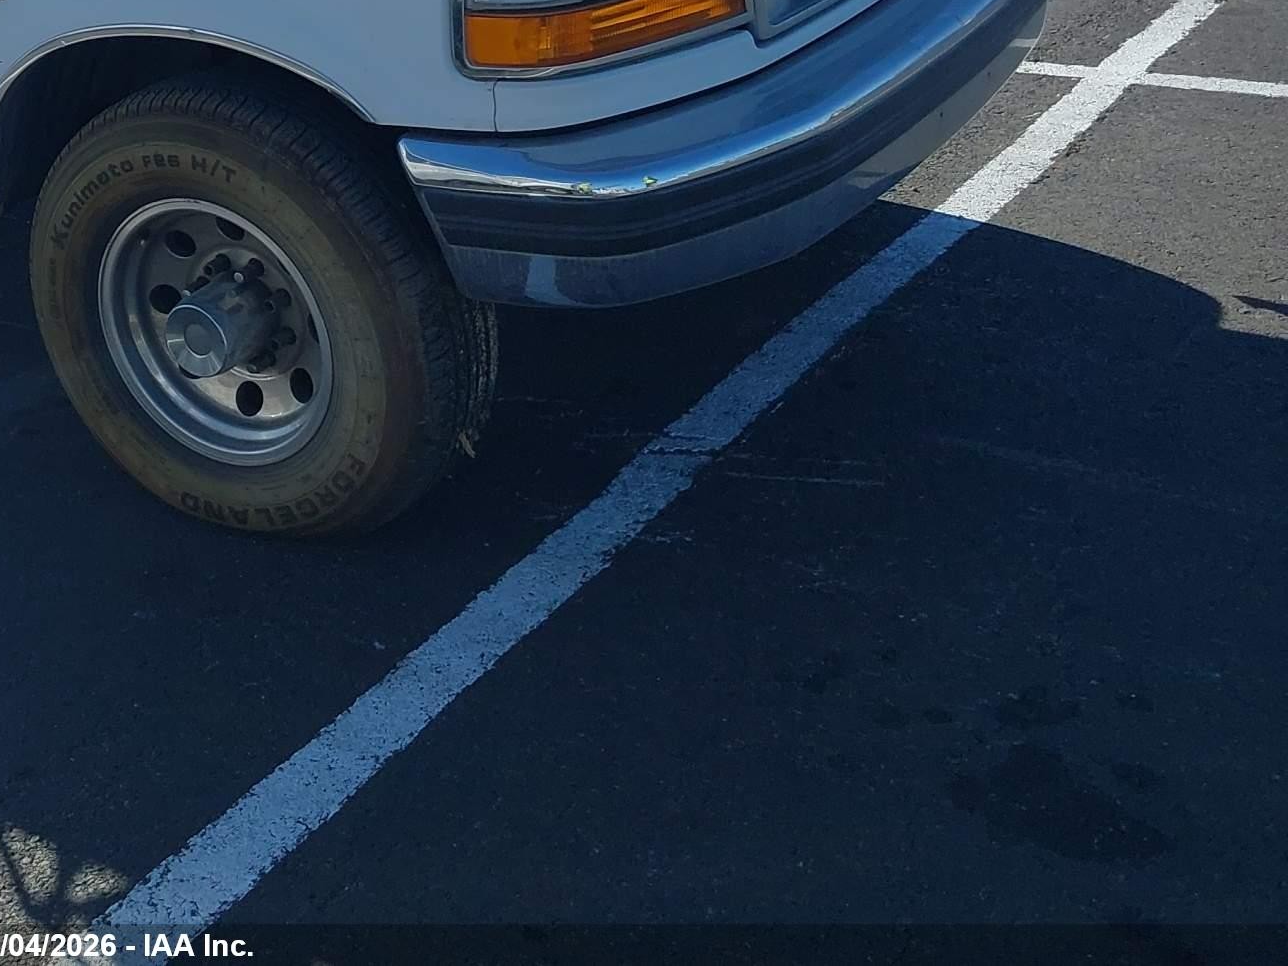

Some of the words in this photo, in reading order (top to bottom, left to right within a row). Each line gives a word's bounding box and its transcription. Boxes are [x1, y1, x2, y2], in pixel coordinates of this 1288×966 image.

[51, 159, 134, 249] Kunimoto
[191, 154, 237, 183] H/T
[179, 452, 366, 526] FORCELAND
